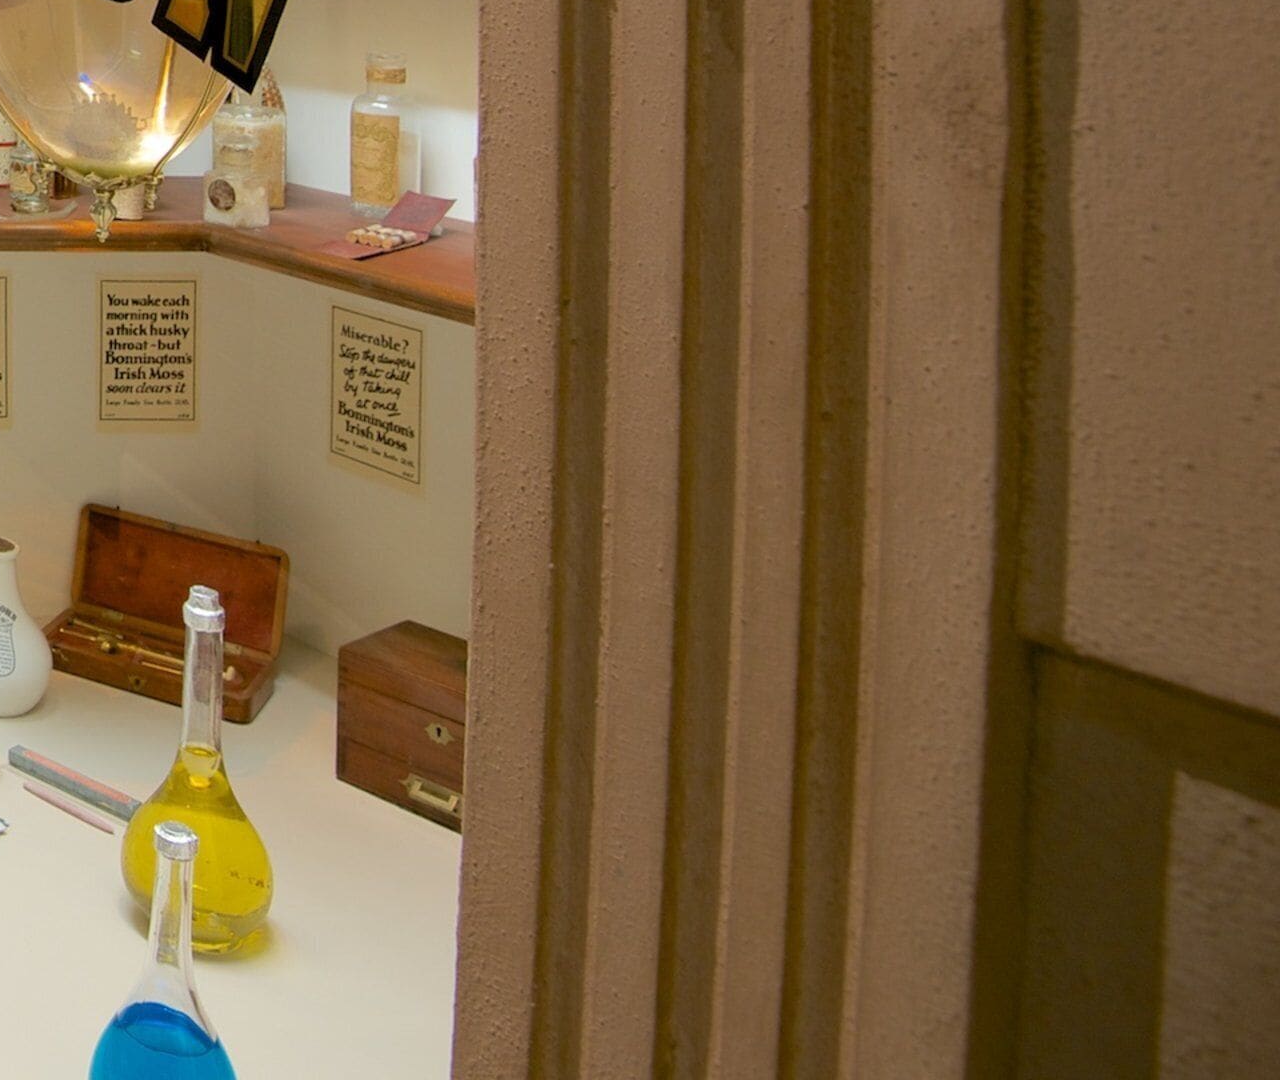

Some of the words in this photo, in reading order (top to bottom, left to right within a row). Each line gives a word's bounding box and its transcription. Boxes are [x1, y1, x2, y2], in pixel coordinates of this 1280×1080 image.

[107, 294, 129, 306] You
[131, 294, 161, 306] wake
[162, 294, 190, 306] each
[106, 308, 157, 323] morning
[161, 309, 189, 320] with
[106, 327, 114, 336] a
[116, 323, 147, 336] thick
[150, 323, 190, 339] husky
[341, 324, 409, 354] Miserable?
[109, 338, 147, 350] throat
[105, 350, 192, 367] Bonnington's
[339, 343, 359, 363] Stop
[362, 349, 375, 364] the
[377, 353, 416, 370] dangers
[114, 367, 146, 380] Irish
[149, 367, 184, 380] Moss
[343, 366, 357, 380] of
[360, 365, 384, 378] that
[385, 368, 410, 385] chill
[106, 384, 133, 394] soon
[135, 382, 172, 394] clears
[175, 382, 186, 394] it
[344, 380, 358, 397] by
[356, 399, 371, 409] at
[372, 401, 399, 412] once
[338, 400, 415, 439] Bonnington's
[345, 420, 374, 440] Irish
[376, 431, 407, 452] Moss
